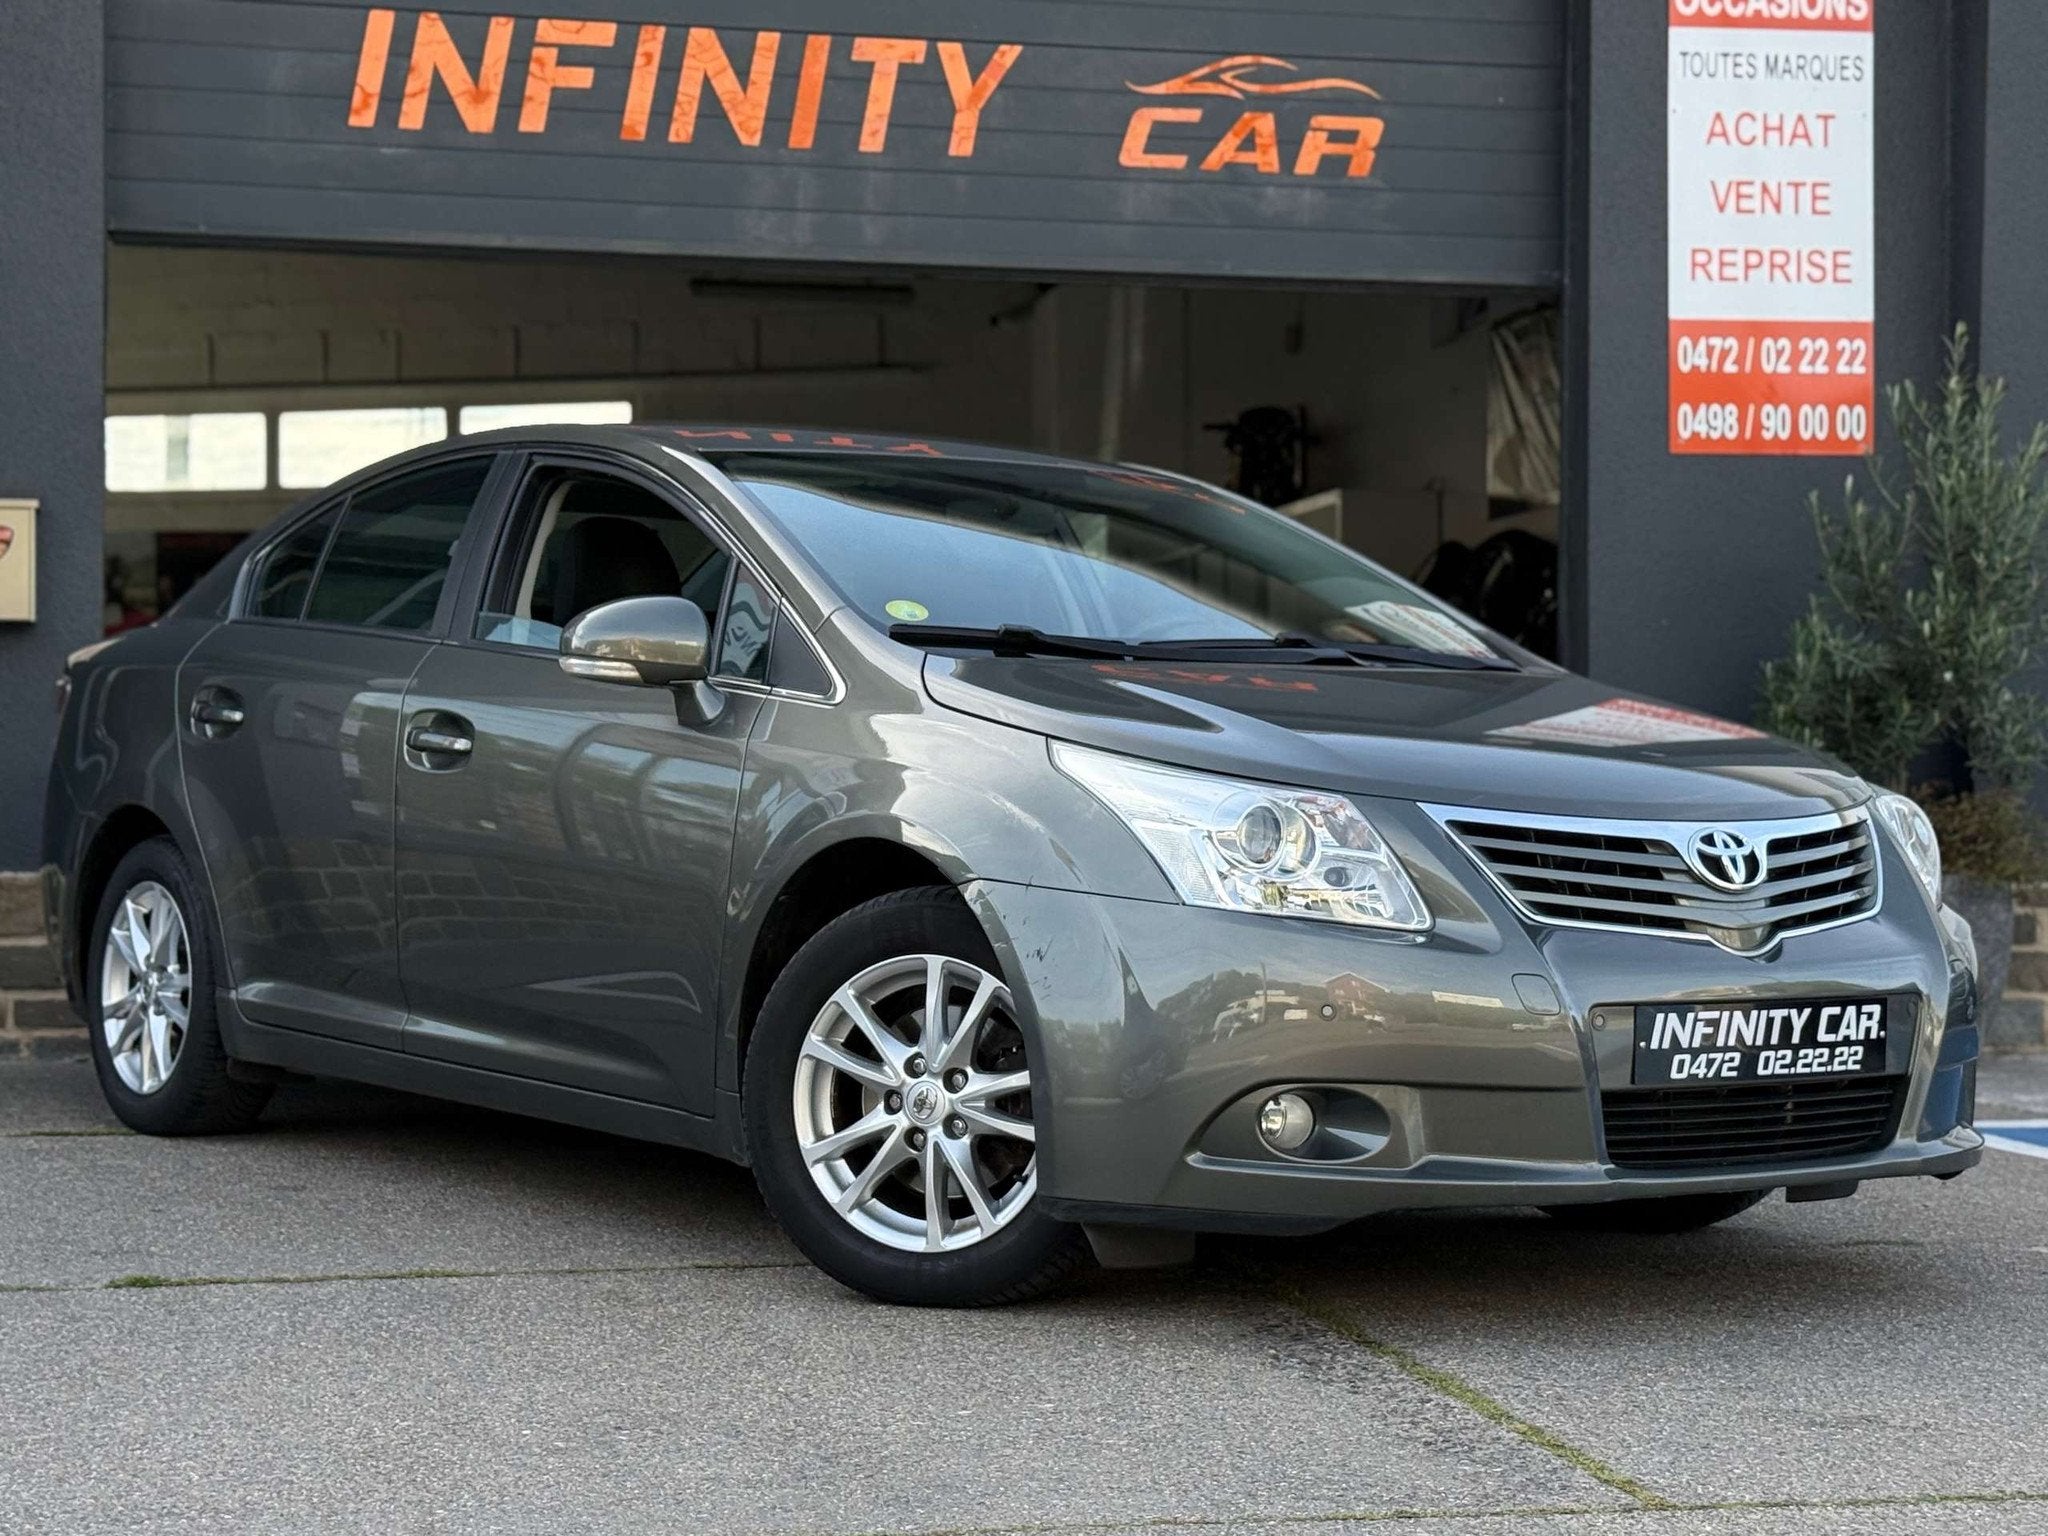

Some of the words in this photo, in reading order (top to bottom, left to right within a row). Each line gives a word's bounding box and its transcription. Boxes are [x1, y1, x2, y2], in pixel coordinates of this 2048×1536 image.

[1680, 51, 1757, 79] TOUTES
[1764, 54, 1864, 82] MARQUES
[347, 9, 1023, 157] INFINITY
[1118, 107, 1385, 178] CAR
[1706, 112, 1836, 147] ACHAT
[1710, 180, 1831, 215] VENTE
[1690, 248, 1853, 284] REPRISE
[1798, 338, 1830, 375] 22
[1836, 338, 1867, 375] 22
[1798, 404, 1830, 441] 00
[1836, 404, 1867, 441] 00
[1650, 1007, 1812, 1050] INFINITY
[1817, 1004, 1882, 1043] CAR
[1669, 1052, 1741, 1080] 0472
[1756, 1045, 1864, 1076] 02.22.22
